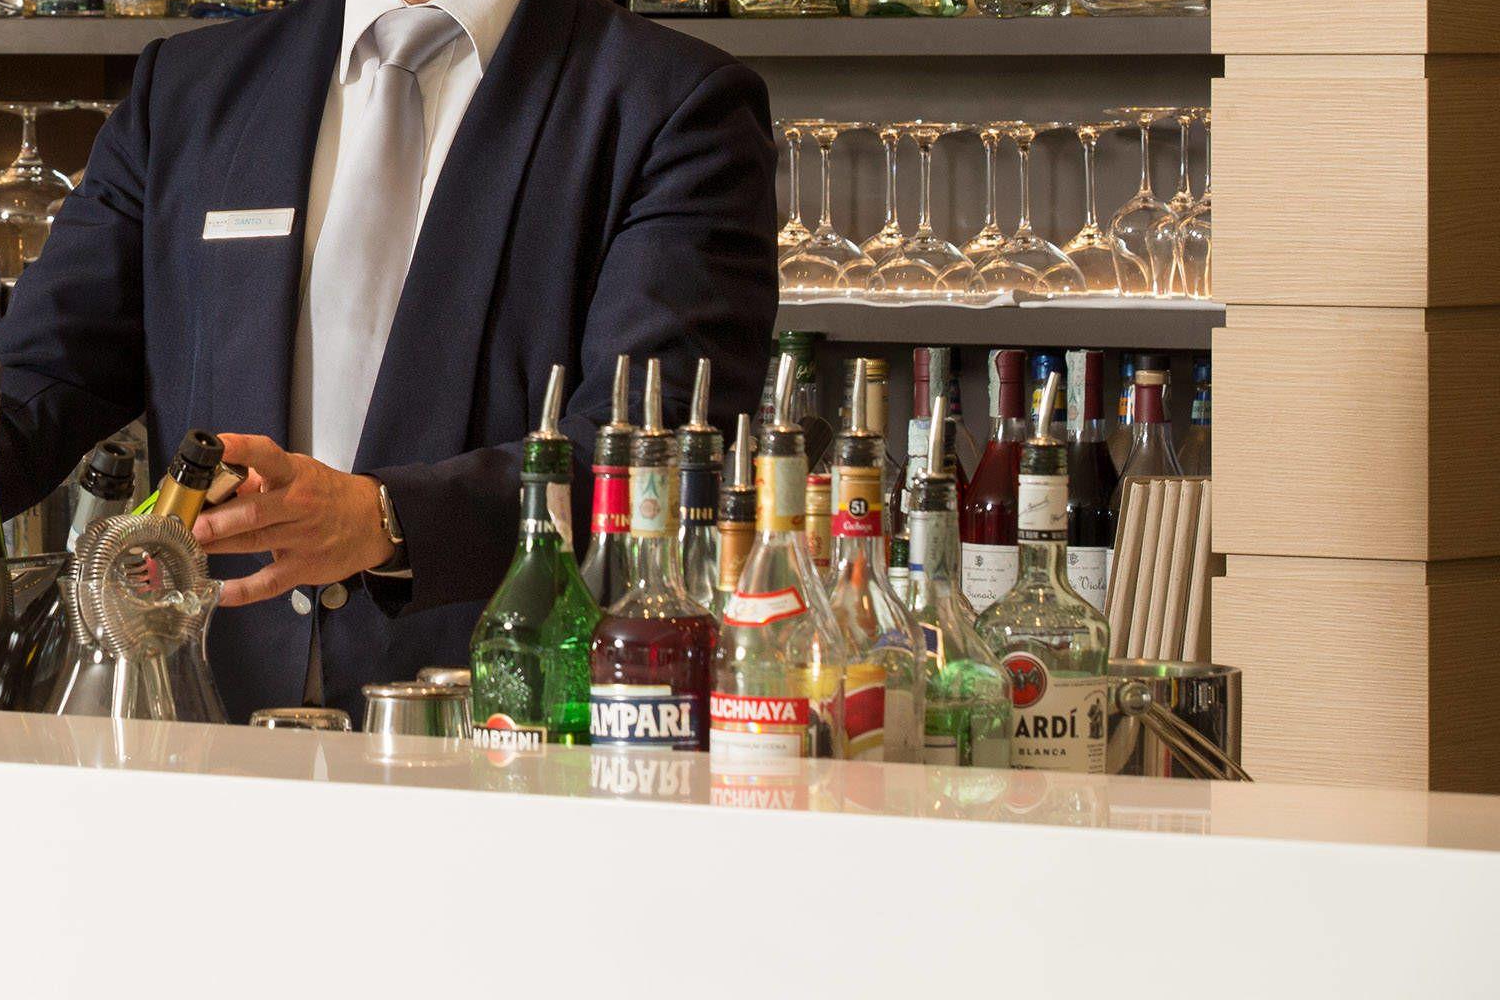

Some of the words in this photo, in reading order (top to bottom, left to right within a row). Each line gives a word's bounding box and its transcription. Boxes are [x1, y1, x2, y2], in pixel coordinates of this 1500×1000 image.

[850, 500, 868, 515] 51
[1014, 708, 1077, 739] ARDÍ
[1019, 747, 1068, 757] BLANCA
